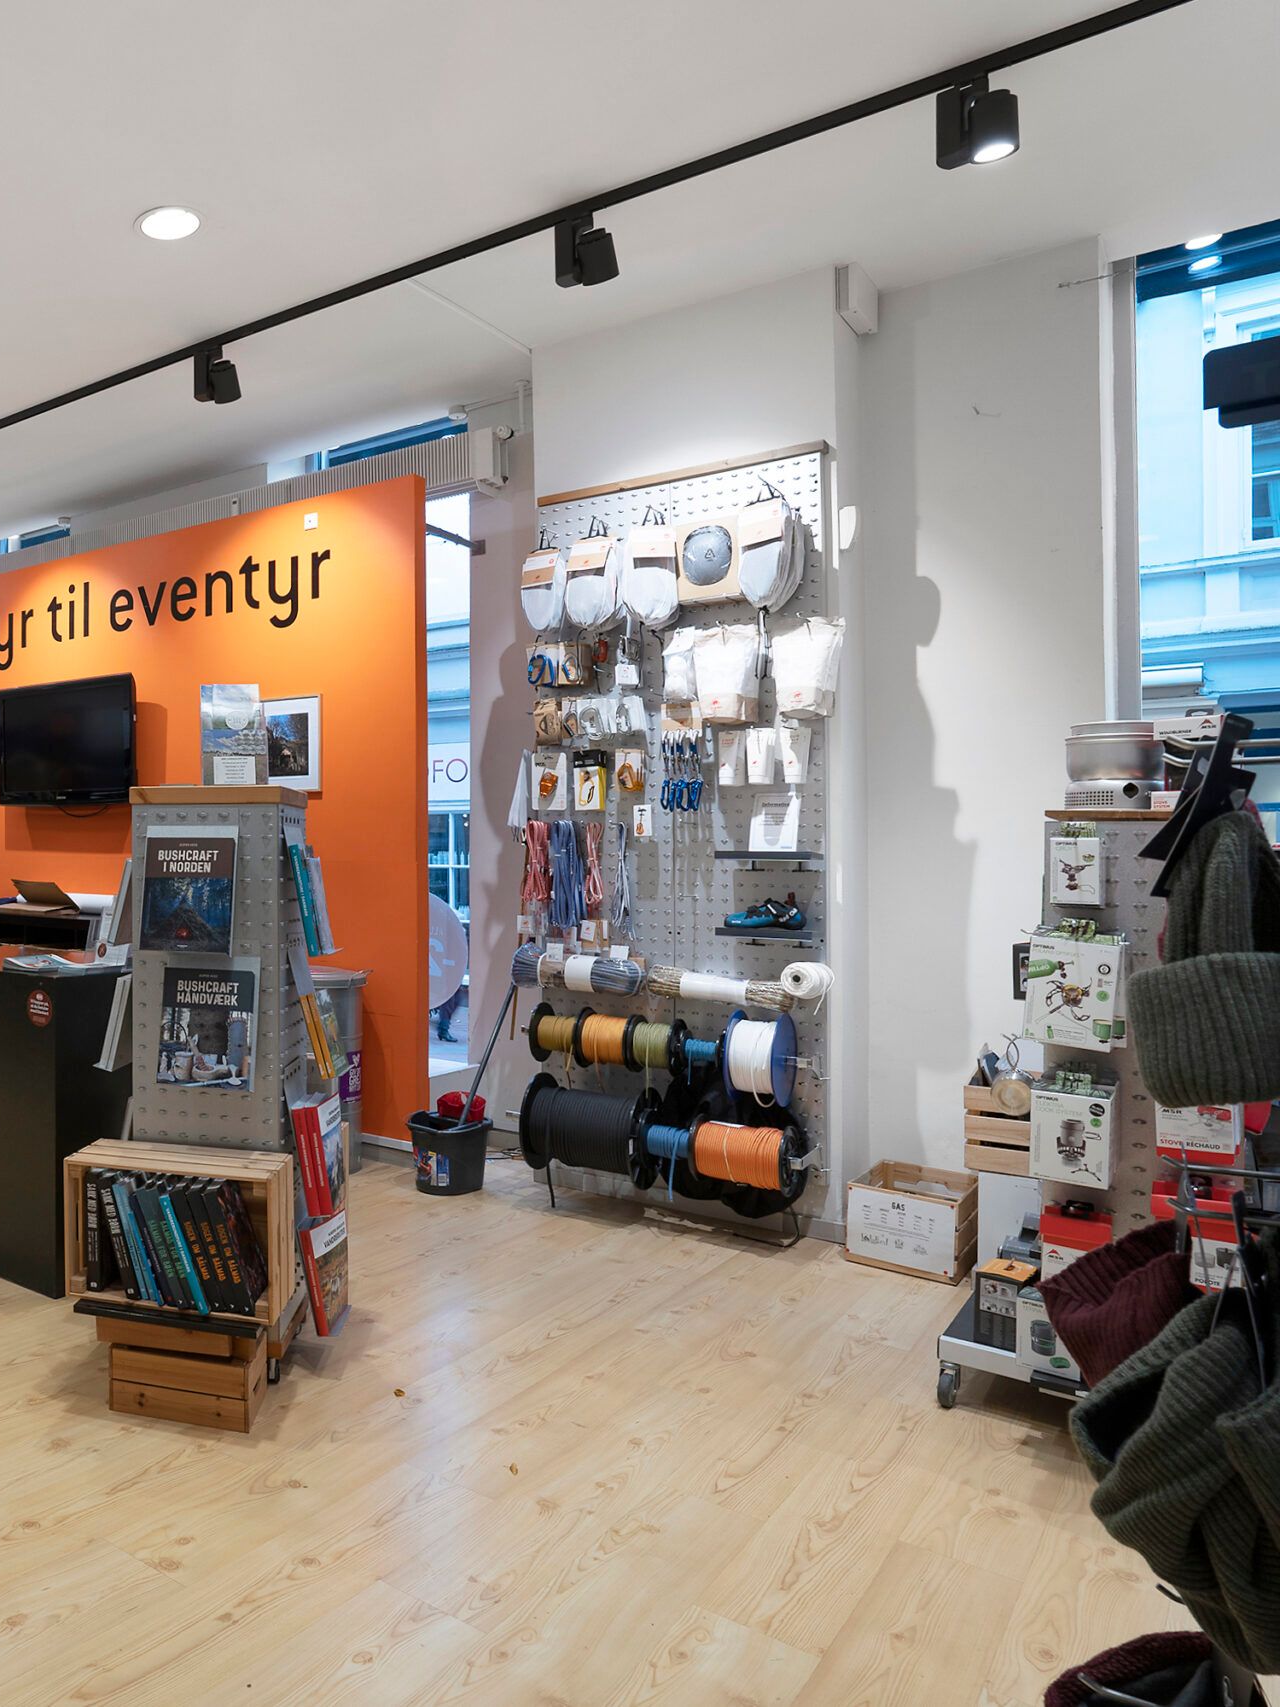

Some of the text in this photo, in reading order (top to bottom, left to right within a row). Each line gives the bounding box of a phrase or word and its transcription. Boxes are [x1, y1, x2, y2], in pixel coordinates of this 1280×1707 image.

[47, 582, 90, 642] til
[109, 549, 331, 629] eventyr
[428, 758, 468, 783] FO
[158, 850, 219, 861] BUSHCRAFT
[163, 861, 211, 873] I NORDEN
[177, 979, 239, 994] BUSHCRAFT
[176, 991, 238, 1006] HÅNDVÆRK
[1186, 1141, 1221, 1150] RÉCHAUD
[891, 1201, 905, 1212] GAS
